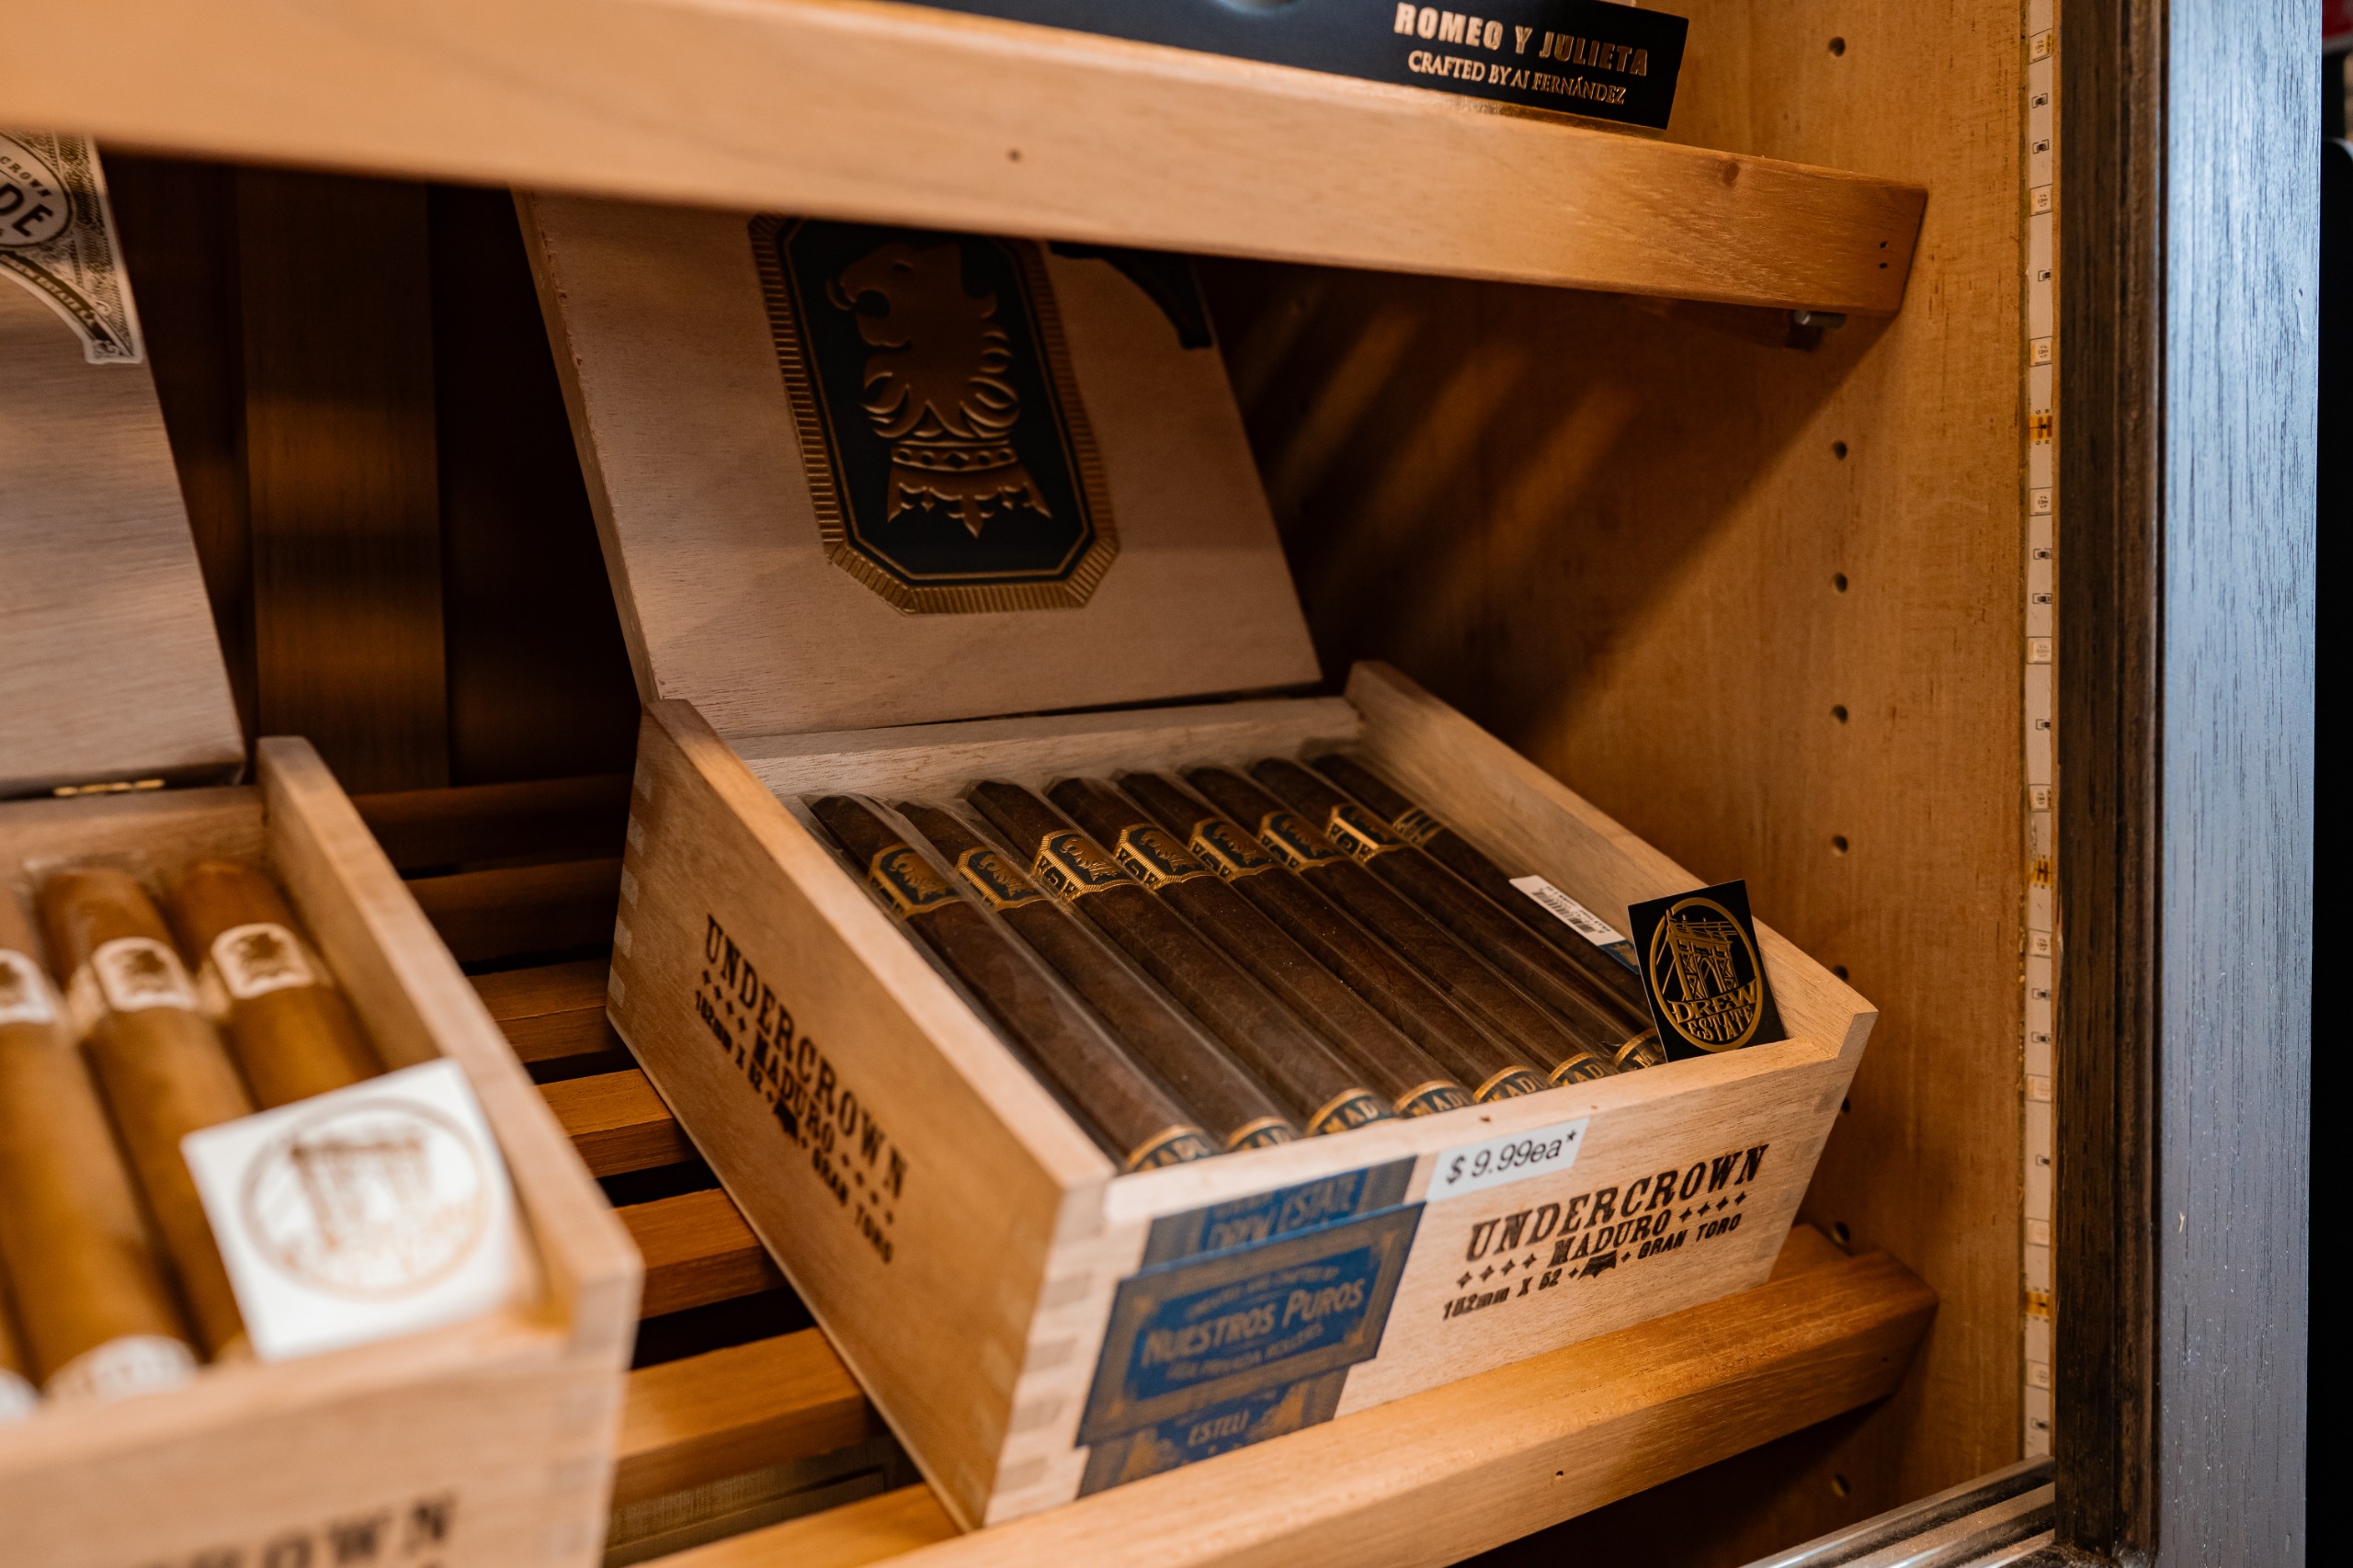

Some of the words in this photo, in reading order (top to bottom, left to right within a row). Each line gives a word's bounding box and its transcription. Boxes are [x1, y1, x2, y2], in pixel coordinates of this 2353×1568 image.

[1393, 1, 1503, 50] ROMEO
[1515, 26, 1533, 54] Y
[1539, 30, 1648, 76] JULIETA
[1408, 50, 1485, 81] CRAFTED
[1488, 63, 1512, 85] BY
[1531, 72, 1626, 105] FERNÁNDEZ
[1666, 976, 1756, 1024] DREW
[1687, 1006, 1754, 1042] ESTATE
[705, 913, 907, 1199] UNDERCROWN
[753, 1029, 835, 1153] MADURO
[1446, 1153, 1466, 1185] $
[1465, 1143, 1769, 1262] UNDERCROWN
[1517, 1277, 1534, 1297] X
[1637, 1233, 1692, 1260] GRAN
[1696, 1213, 1742, 1241] TORO
[1547, 1210, 1672, 1267] MADURO
[1142, 1301, 1277, 1368] NUESTROS
[1281, 1278, 1366, 1328] PUROS
